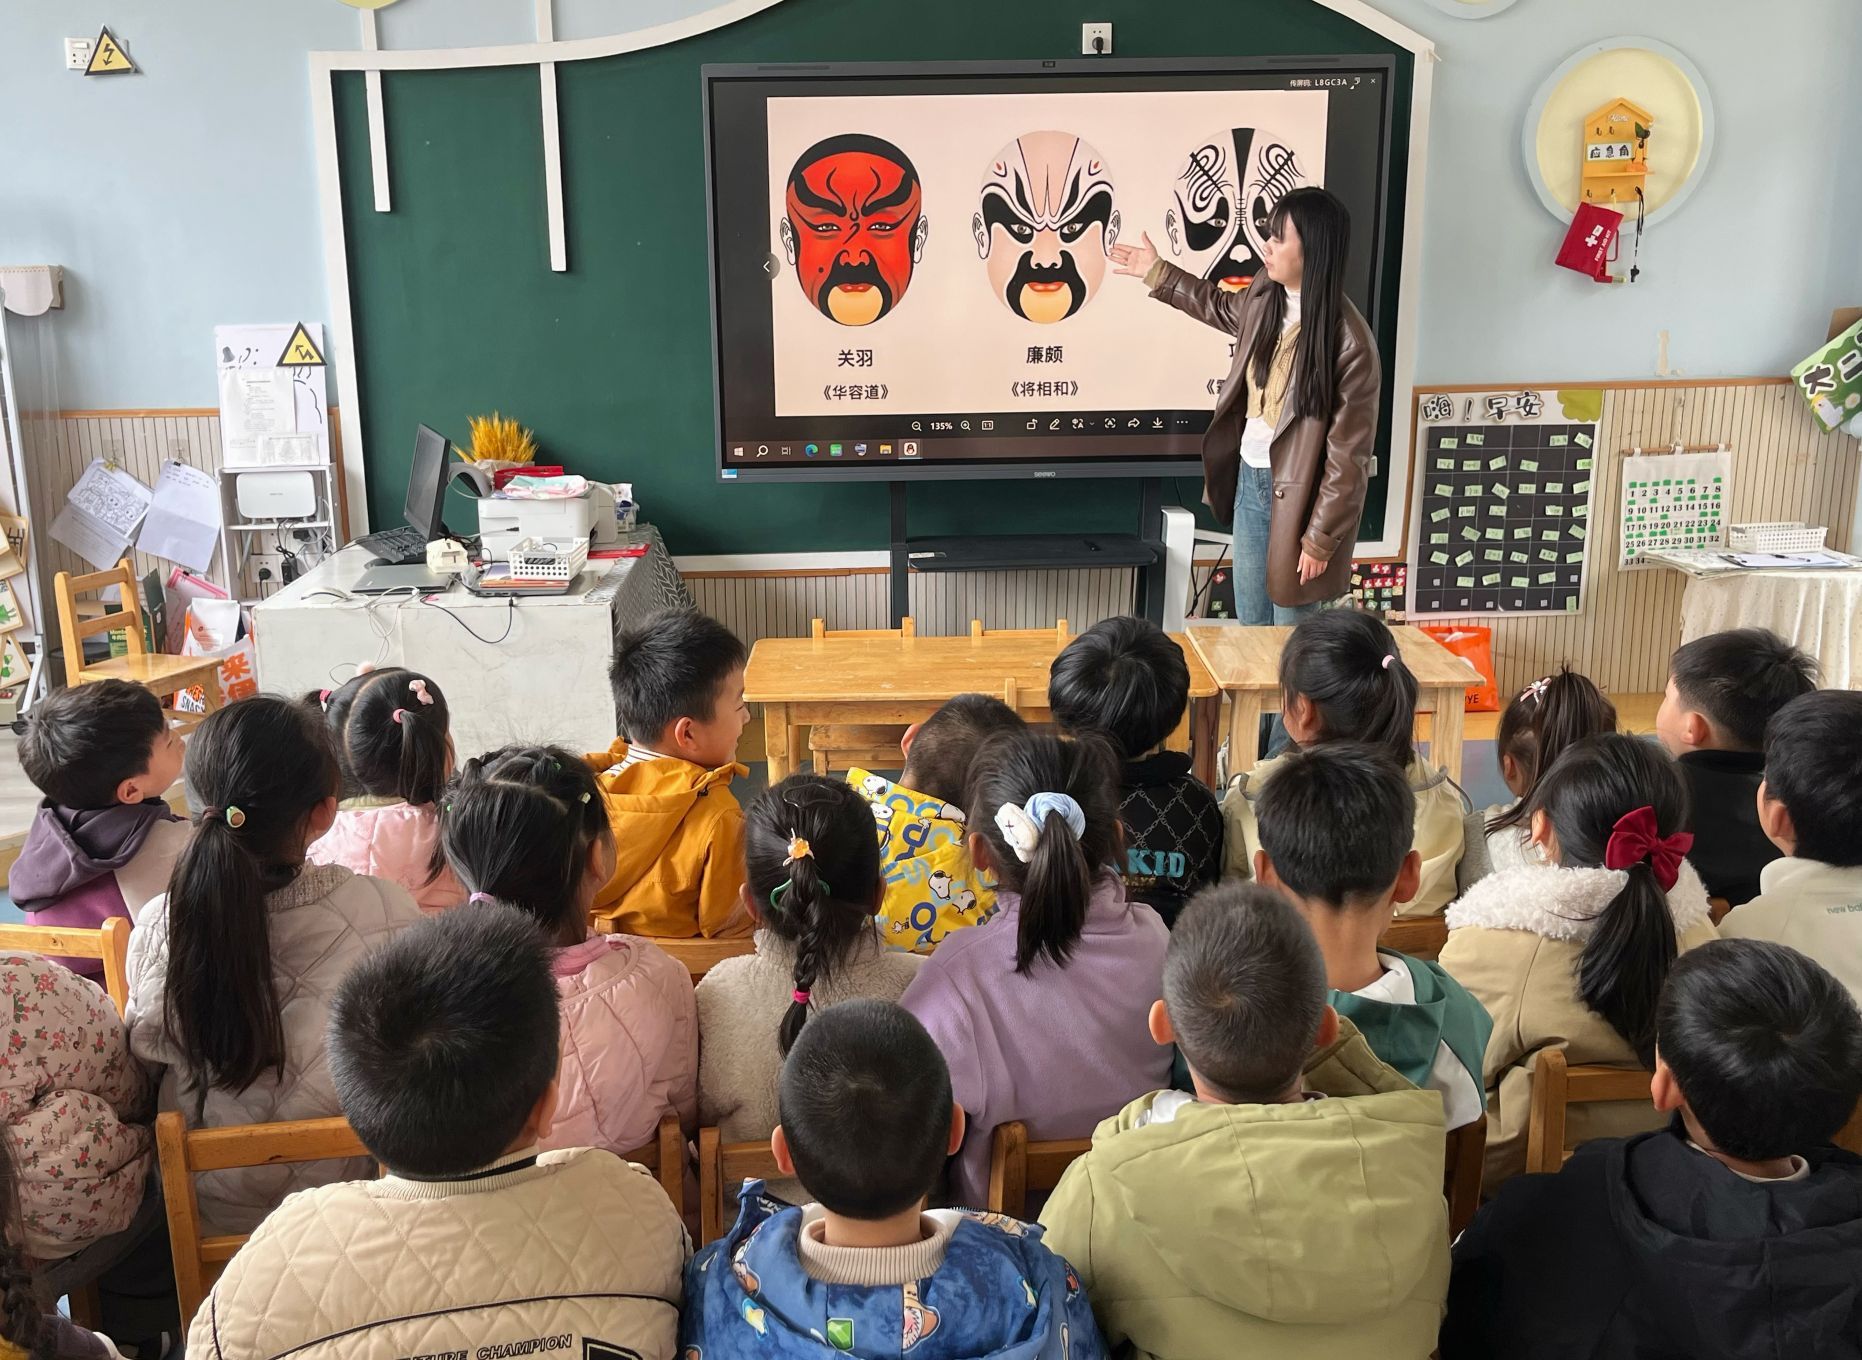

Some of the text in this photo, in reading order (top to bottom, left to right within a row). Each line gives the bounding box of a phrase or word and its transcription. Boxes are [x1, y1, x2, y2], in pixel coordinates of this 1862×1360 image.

[838, 349, 873, 367] 关羽
[1026, 345, 1063, 363] 廉颇
[823, 384, 889, 400] 《华容道》
[1011, 380, 1079, 397] 《将相和》
[930, 422, 953, 430] 135%
[477, 1334, 572, 1360] CHAMPION
